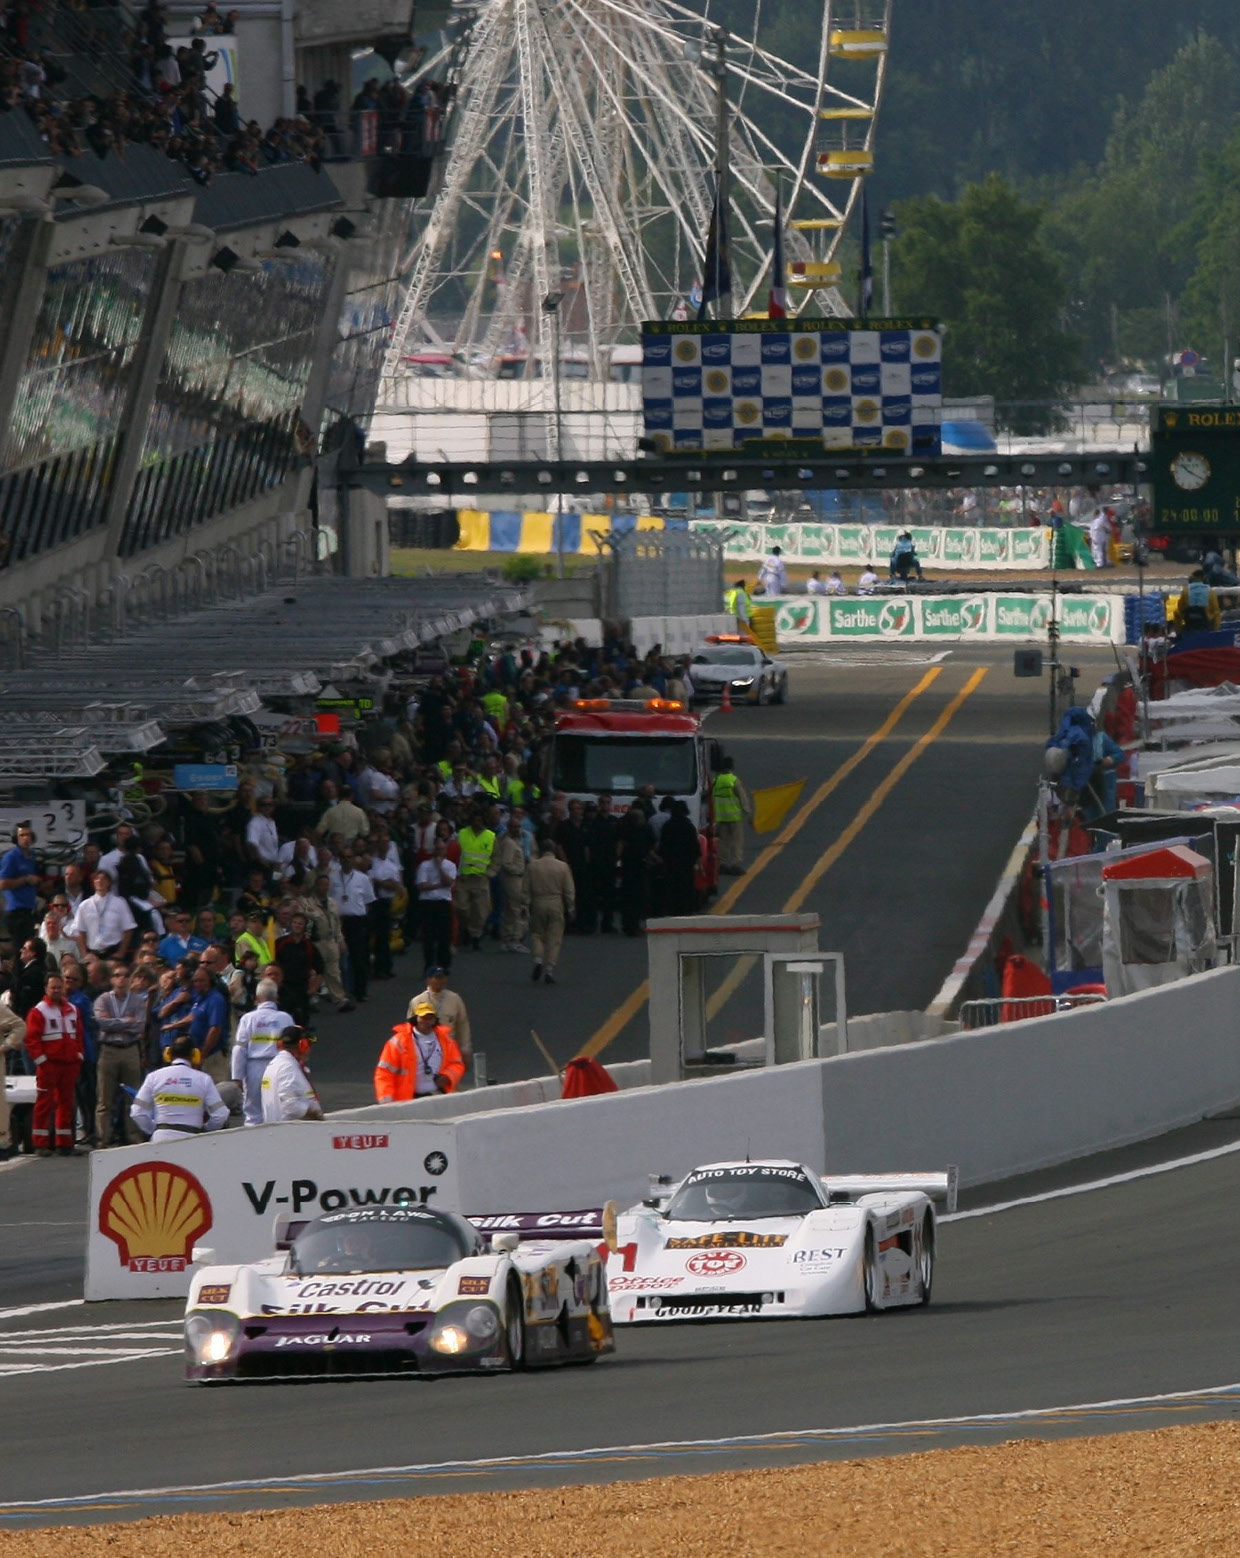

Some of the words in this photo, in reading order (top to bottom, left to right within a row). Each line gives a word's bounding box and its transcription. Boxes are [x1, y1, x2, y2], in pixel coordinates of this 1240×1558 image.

[668, 323, 710, 333] ROLEX
[735, 322, 778, 332] ROLEX
[802, 320, 845, 330] ROLEX
[869, 319, 914, 330] ROLEX
[834, 608, 877, 629] Sarthe
[925, 608, 960, 628] Sarthe
[999, 606, 1029, 626] Sarthe
[1063, 606, 1087, 625] Sarthe
[687, 1169, 725, 1185] AUTO
[729, 1167, 760, 1176] TOY
[760, 1167, 808, 1182] STORE
[241, 1179, 437, 1215] V-Power
[466, 1214, 525, 1229] Silk
[536, 1211, 601, 1227] Cut
[691, 1259, 742, 1271] TOY
[461, 1278, 489, 1286] SILK
[609, 1276, 686, 1285] Office
[201, 1287, 229, 1295] SILK
[298, 1278, 407, 1298] Castrol
[461, 1285, 487, 1294] CUT
[609, 1283, 676, 1292] DEPOT
[200, 1295, 228, 1303] CUT
[275, 1334, 372, 1347] JAGUAR
